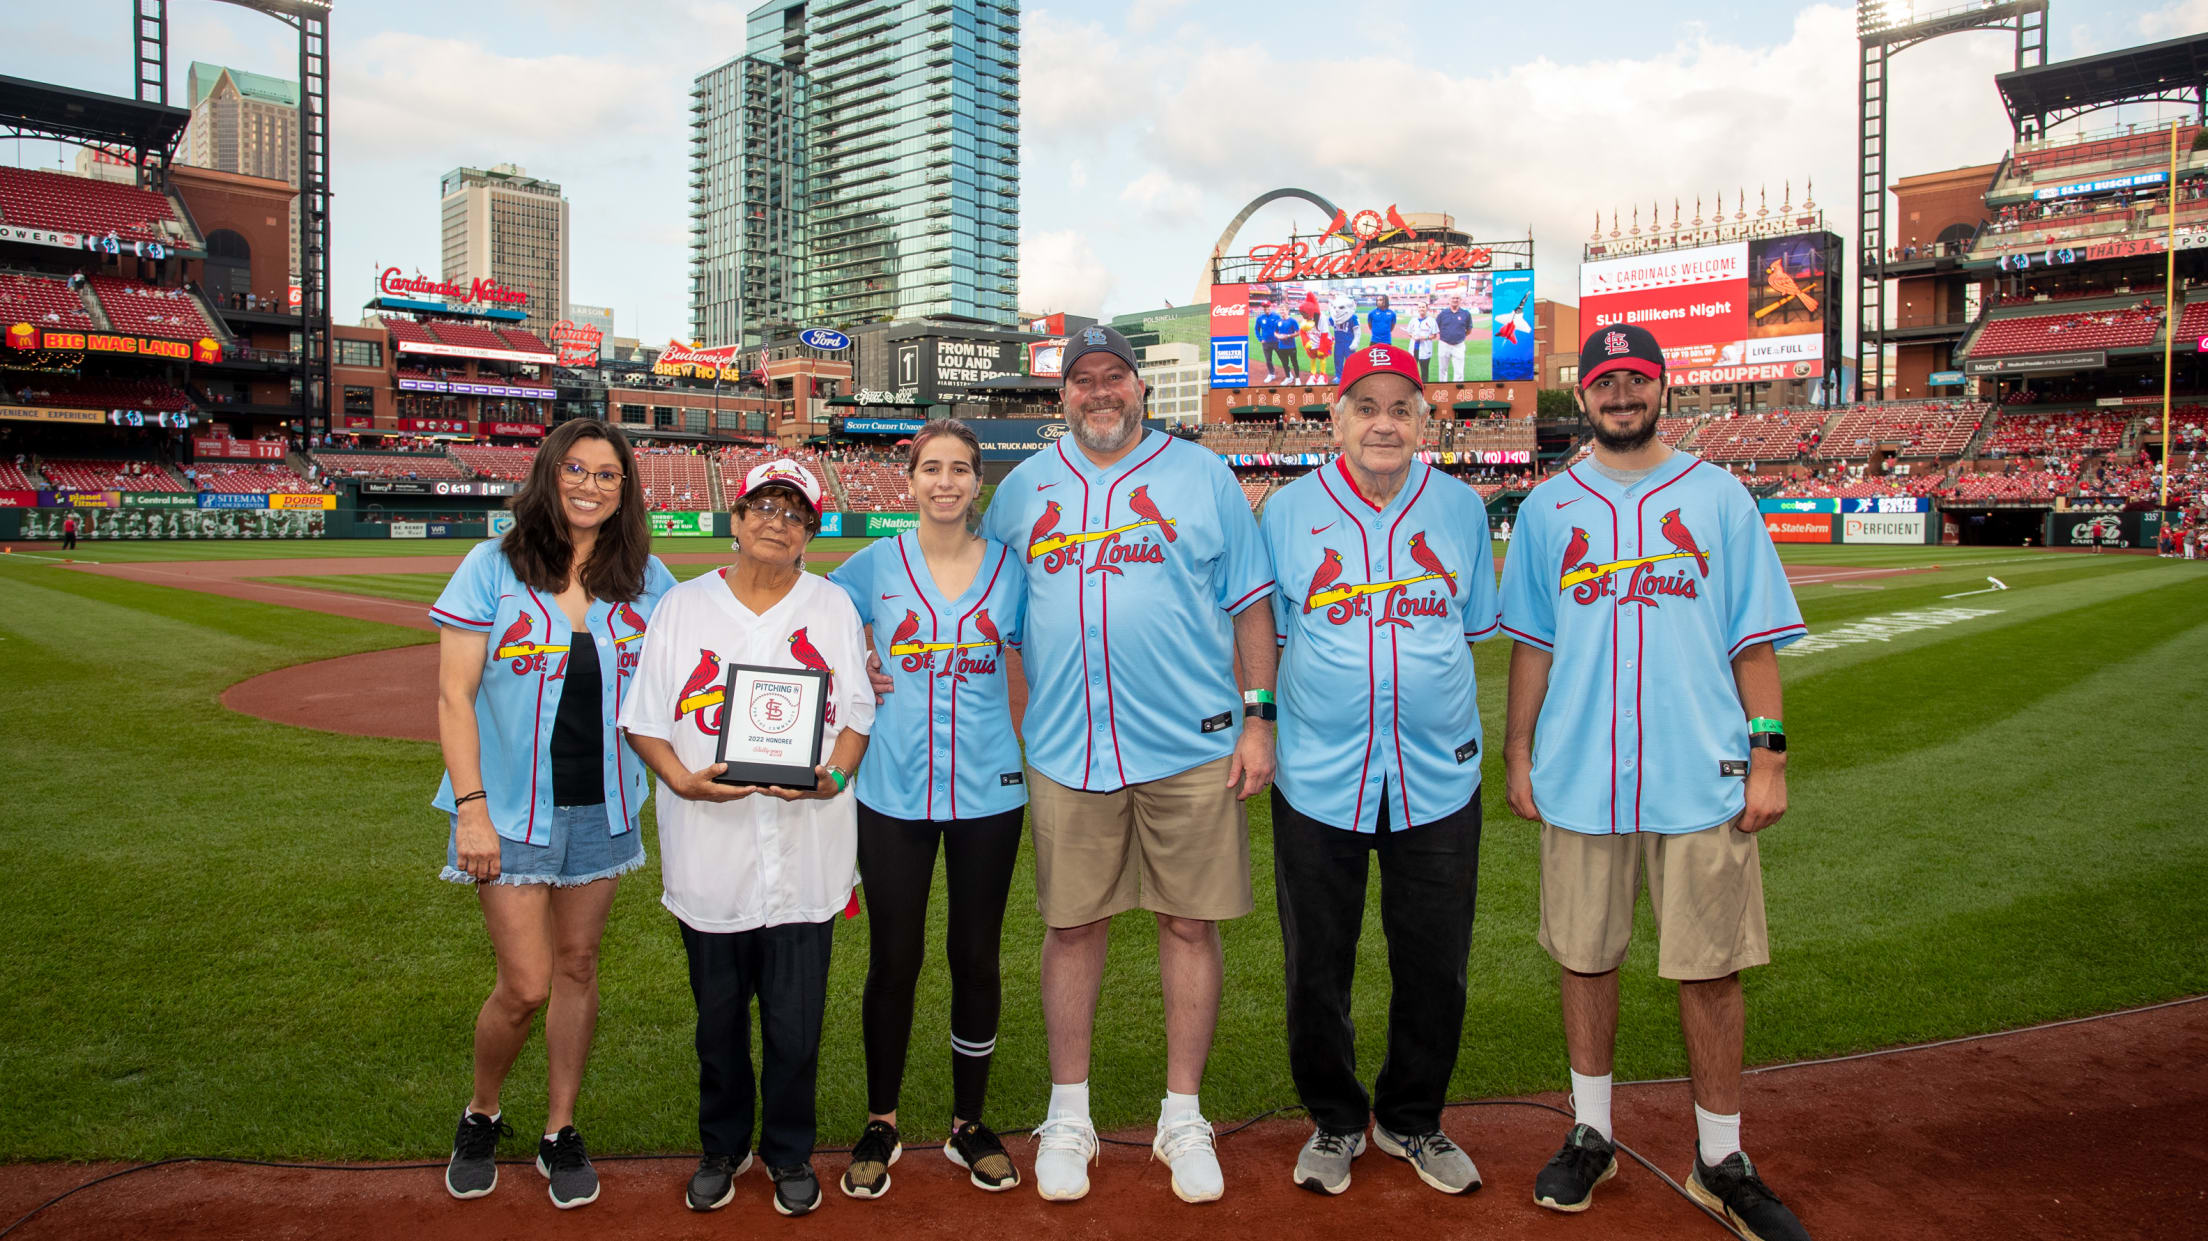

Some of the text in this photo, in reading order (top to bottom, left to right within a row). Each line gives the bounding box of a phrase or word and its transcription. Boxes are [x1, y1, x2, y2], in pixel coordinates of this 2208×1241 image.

[1606, 217, 1798, 255] WORLD CHAMPIONS
[2089, 243, 2136, 258] THAT'S
[1250, 238, 1492, 282] Budweiser
[1616, 257, 1737, 283] CARDINALS WELCOME
[381, 267, 527, 304] Cardinals Nation
[1213, 304, 1246, 317] Coca-Cola
[1596, 301, 1731, 326] SLU Billikens Night
[809, 329, 840, 346] Ford
[44, 333, 190, 358] BIG MAC LAND
[938, 342, 1000, 357] FROM THE
[1752, 347, 1772, 356] LIVE
[1781, 344, 1803, 353] FULL
[658, 346, 738, 364] Budweiser
[938, 355, 992, 370] LOU AND
[1975, 363, 1997, 371] Mercy
[655, 363, 693, 377] BREW
[938, 368, 978, 381] WE'RE
[1674, 375, 1684, 385] &
[1688, 365, 1784, 384] CROUPPEN
[1247, 394, 1252, 406] 1
[1259, 394, 1267, 406] 2
[1432, 390, 1448, 402] 42
[1456, 389, 1473, 401] 45
[259, 446, 280, 457] 170
[997, 442, 1020, 450] TRUCK
[1022, 442, 1037, 450] AND
[451, 484, 471, 493] 6:19
[69, 493, 101, 503] planet
[137, 496, 196, 504] Central Bank
[217, 494, 264, 503] SITEMAN
[284, 496, 323, 505] DOBBS
[1781, 501, 1816, 511] ecologic
[1846, 520, 1920, 536] PERFICIENT
[1044, 532, 1165, 576] St. Louis
[1573, 561, 1697, 608] St. Louis
[1327, 583, 1448, 630] St. Louis
[902, 639, 996, 684] St. Louis
[755, 683, 792, 693] PITCHING
[765, 737, 792, 745] HONOREE
